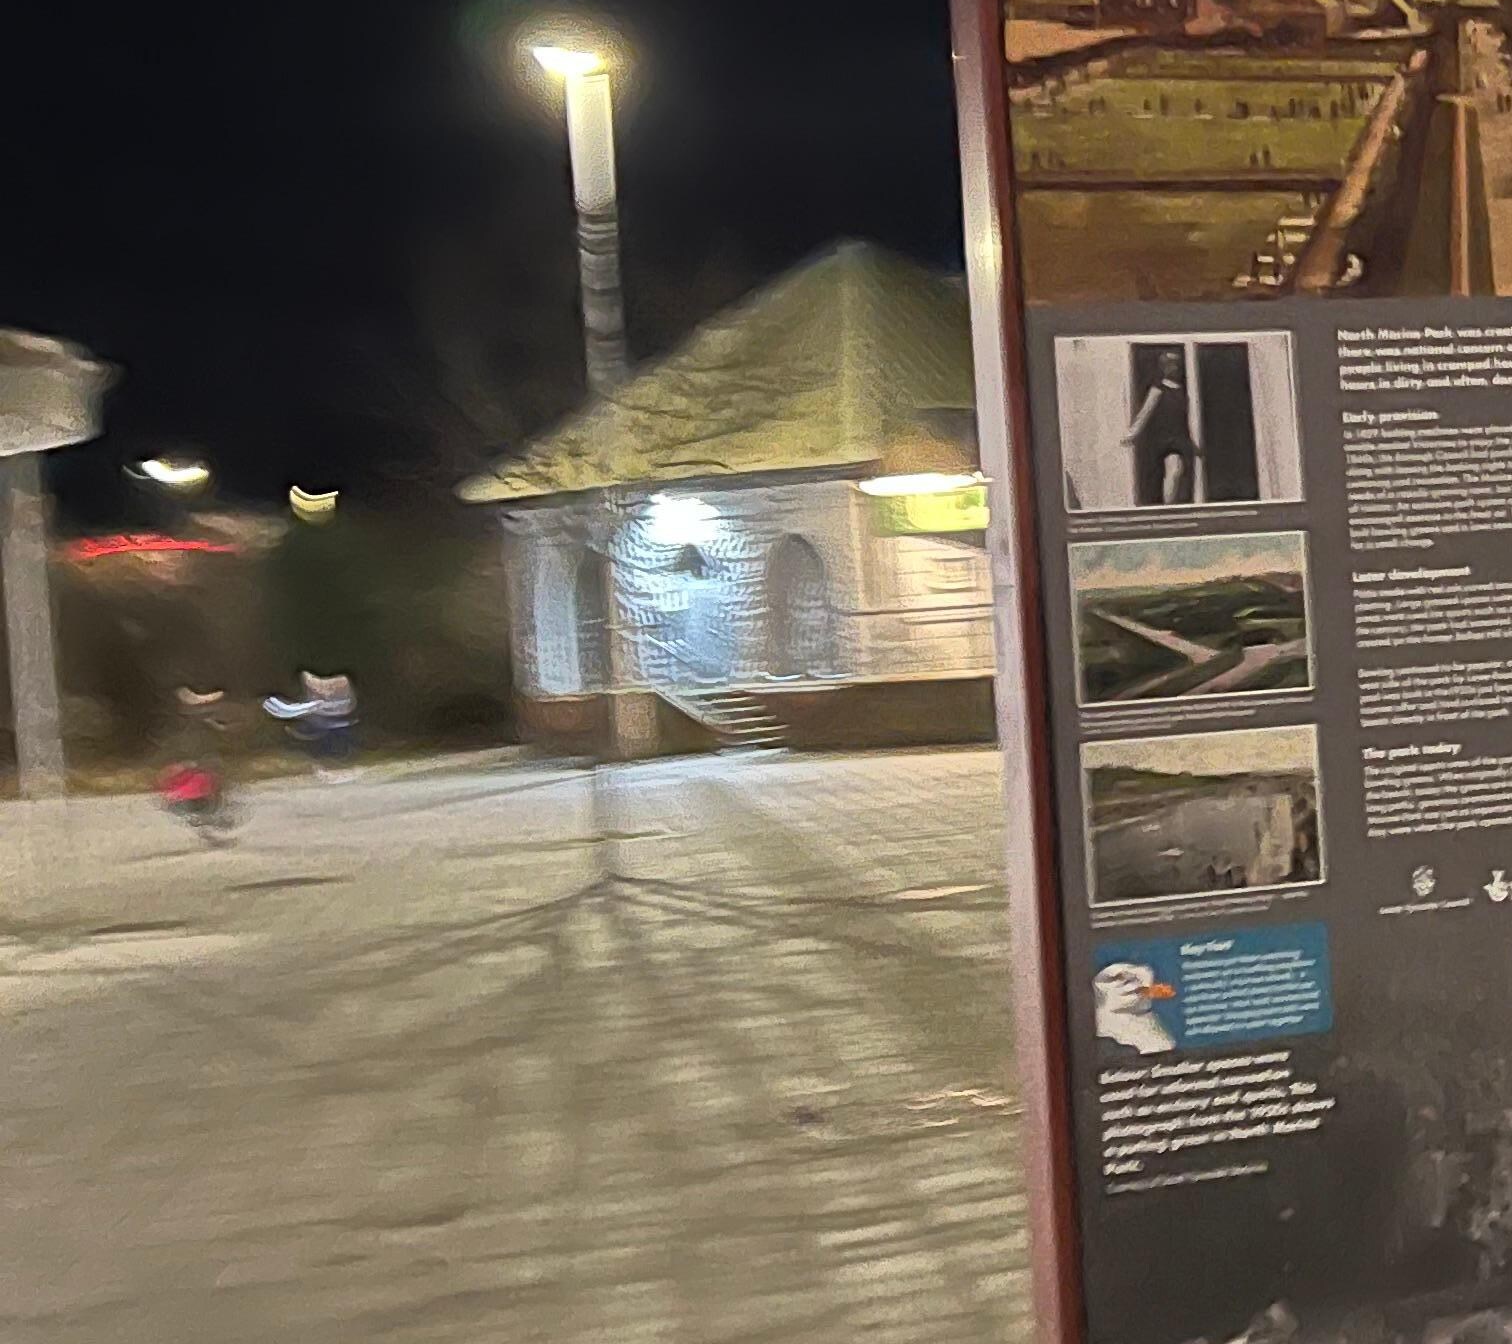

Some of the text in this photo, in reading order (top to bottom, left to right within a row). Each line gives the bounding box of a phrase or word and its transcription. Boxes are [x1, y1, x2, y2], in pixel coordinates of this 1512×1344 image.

[1338, 327, 1375, 341] North
[1378, 327, 1421, 341] Marine
[1424, 325, 1452, 339] Park
[1457, 327, 1482, 338] was
[1385, 360, 1422, 374] living
[1423, 358, 1434, 371] in
[1378, 378, 1390, 389] in
[1342, 410, 1376, 424] Early
